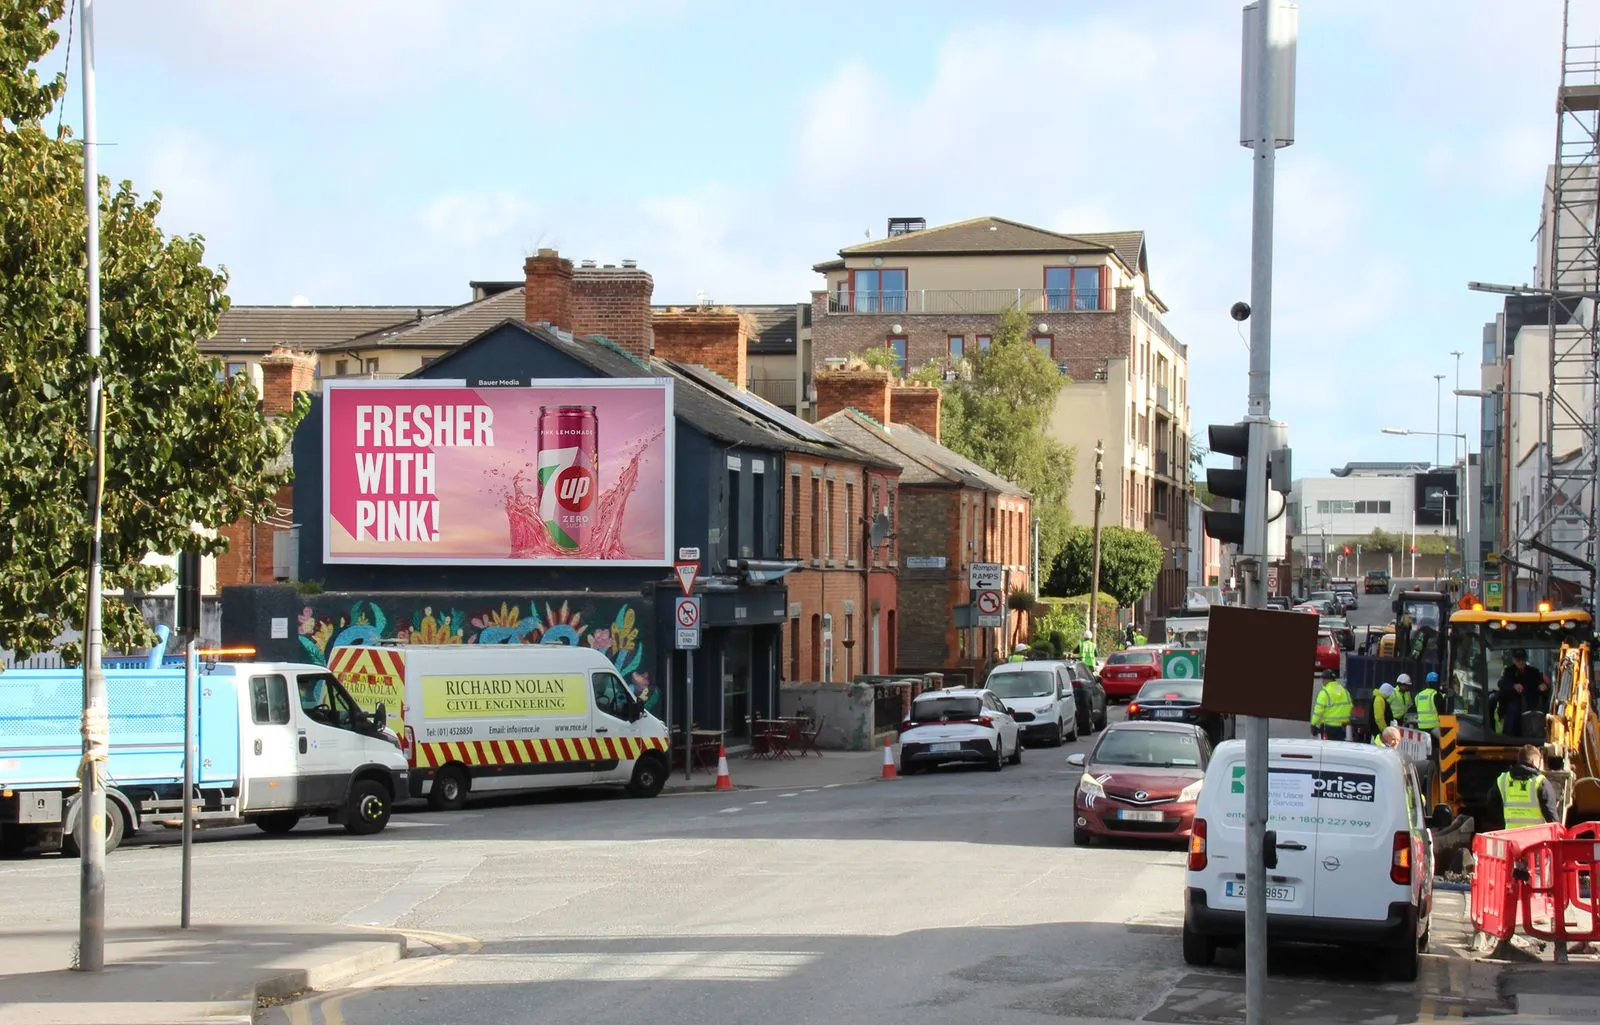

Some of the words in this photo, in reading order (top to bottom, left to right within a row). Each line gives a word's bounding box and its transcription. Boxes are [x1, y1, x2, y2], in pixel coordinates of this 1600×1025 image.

[499, 378, 520, 386] Media
[356, 404, 494, 447] FRESHER
[354, 452, 436, 495] WITH
[356, 499, 440, 542] PINK!
[562, 515, 589, 523] ZERO
[679, 566, 695, 574] YIELD
[367, 682, 398, 695] NOLAN
[446, 679, 511, 696] RICHARD
[515, 678, 564, 694] NOLAN
[446, 700, 482, 710] CIVIL
[485, 698, 565, 710] ENGINEERING
[426, 728, 437, 736] Tel:
[437, 727, 449, 737] (01)
[449, 726, 474, 736] 4528850
[489, 725, 506, 735] Email:
[1312, 776, 1374, 797] prise
[1322, 790, 1373, 801] rent-a-car
[1299, 815, 1324, 825] 1800
[1327, 817, 1347, 826] 227
[1350, 819, 1372, 828] 999
